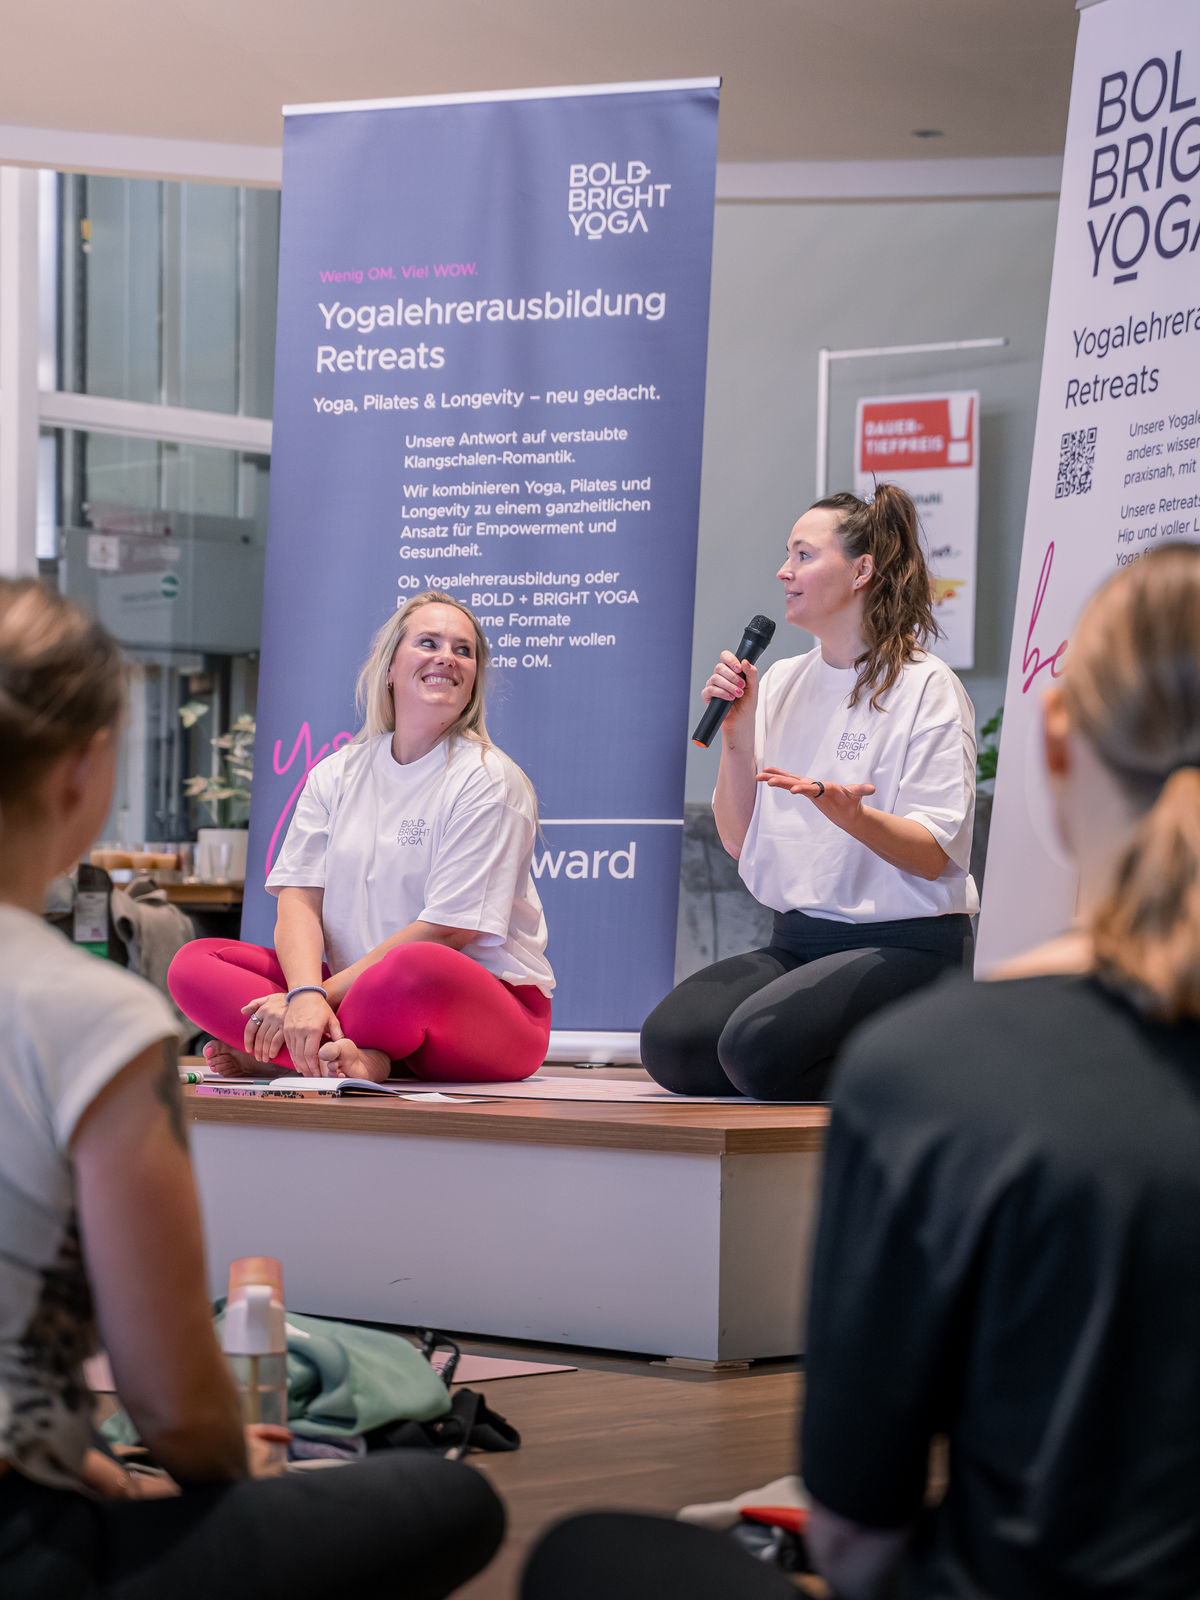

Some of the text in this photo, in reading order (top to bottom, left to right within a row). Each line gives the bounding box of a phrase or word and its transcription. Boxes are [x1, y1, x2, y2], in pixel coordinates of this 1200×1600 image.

[568, 184, 671, 212] BRIGHT
[569, 210, 648, 240] YOGA
[320, 264, 478, 284] Wenig OM. Viel WOW.
[318, 289, 665, 333] Yogalehrerausbildung
[317, 343, 445, 373] Retreats
[1066, 366, 1159, 408] Retreats
[313, 398, 358, 414] Yoga,
[364, 394, 418, 410] Pilates
[424, 393, 435, 408] &
[441, 389, 524, 409] Longevity
[547, 391, 578, 403] neu
[584, 384, 660, 405] gedacht.
[406, 427, 627, 448] Unsere Antwort auf verstaubte
[1130, 420, 1164, 437] Unsere
[865, 434, 944, 455] TIEFPREIS
[1127, 444, 1163, 461] anders:
[405, 450, 575, 470] Klangschalen-Romantik.
[1124, 459, 1196, 488] praxisnah, mit
[403, 477, 650, 498] Wir kombinieren Yoga, Pilates und
[402, 498, 650, 520] Longevity zu einem ganzheitlichen
[1121, 503, 1155, 519] Unsere
[400, 519, 616, 538] Ansatz für Empowerment und
[1118, 529, 1134, 544] Hip
[1138, 524, 1157, 540] und
[1161, 520, 1190, 536] voller
[400, 543, 482, 559] Gesundheit.
[398, 570, 619, 589] Ob Yogalehrerausbildung oder
[472, 593, 514, 606] BOLD
[519, 595, 528, 604] +
[533, 592, 590, 605] BRIGHT
[595, 590, 639, 604] YOGA
[477, 613, 571, 627] rne Formate
[498, 634, 521, 647] die
[526, 634, 564, 647] mehr
[569, 633, 615, 646] wollen
[489, 654, 551, 668] che OM.
